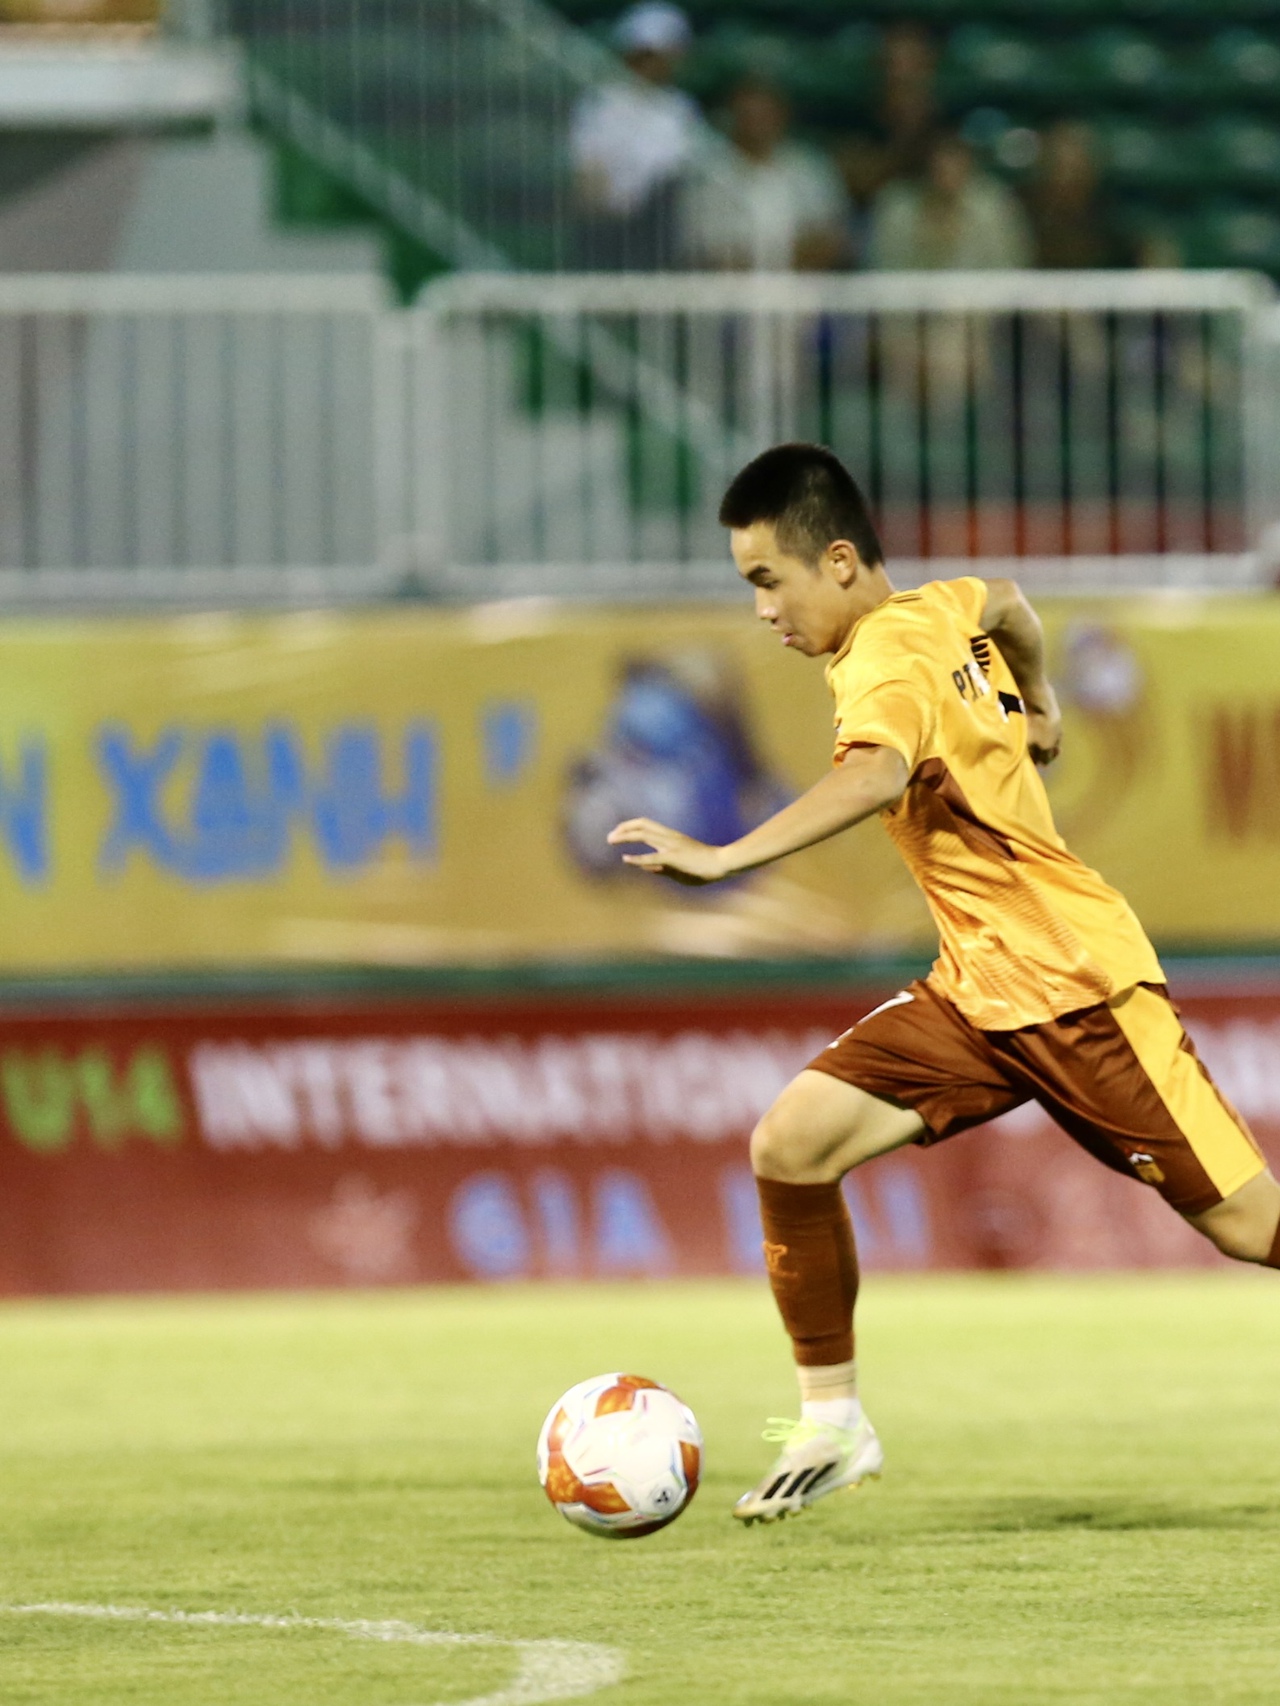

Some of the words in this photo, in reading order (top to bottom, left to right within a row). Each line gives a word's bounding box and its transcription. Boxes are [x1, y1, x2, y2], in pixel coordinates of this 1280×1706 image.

[94, 717, 442, 884] XANH
[2, 1042, 184, 1153] U14
[190, 1032, 838, 1152] INTERNATION
[447, 1165, 672, 1280] GIA
